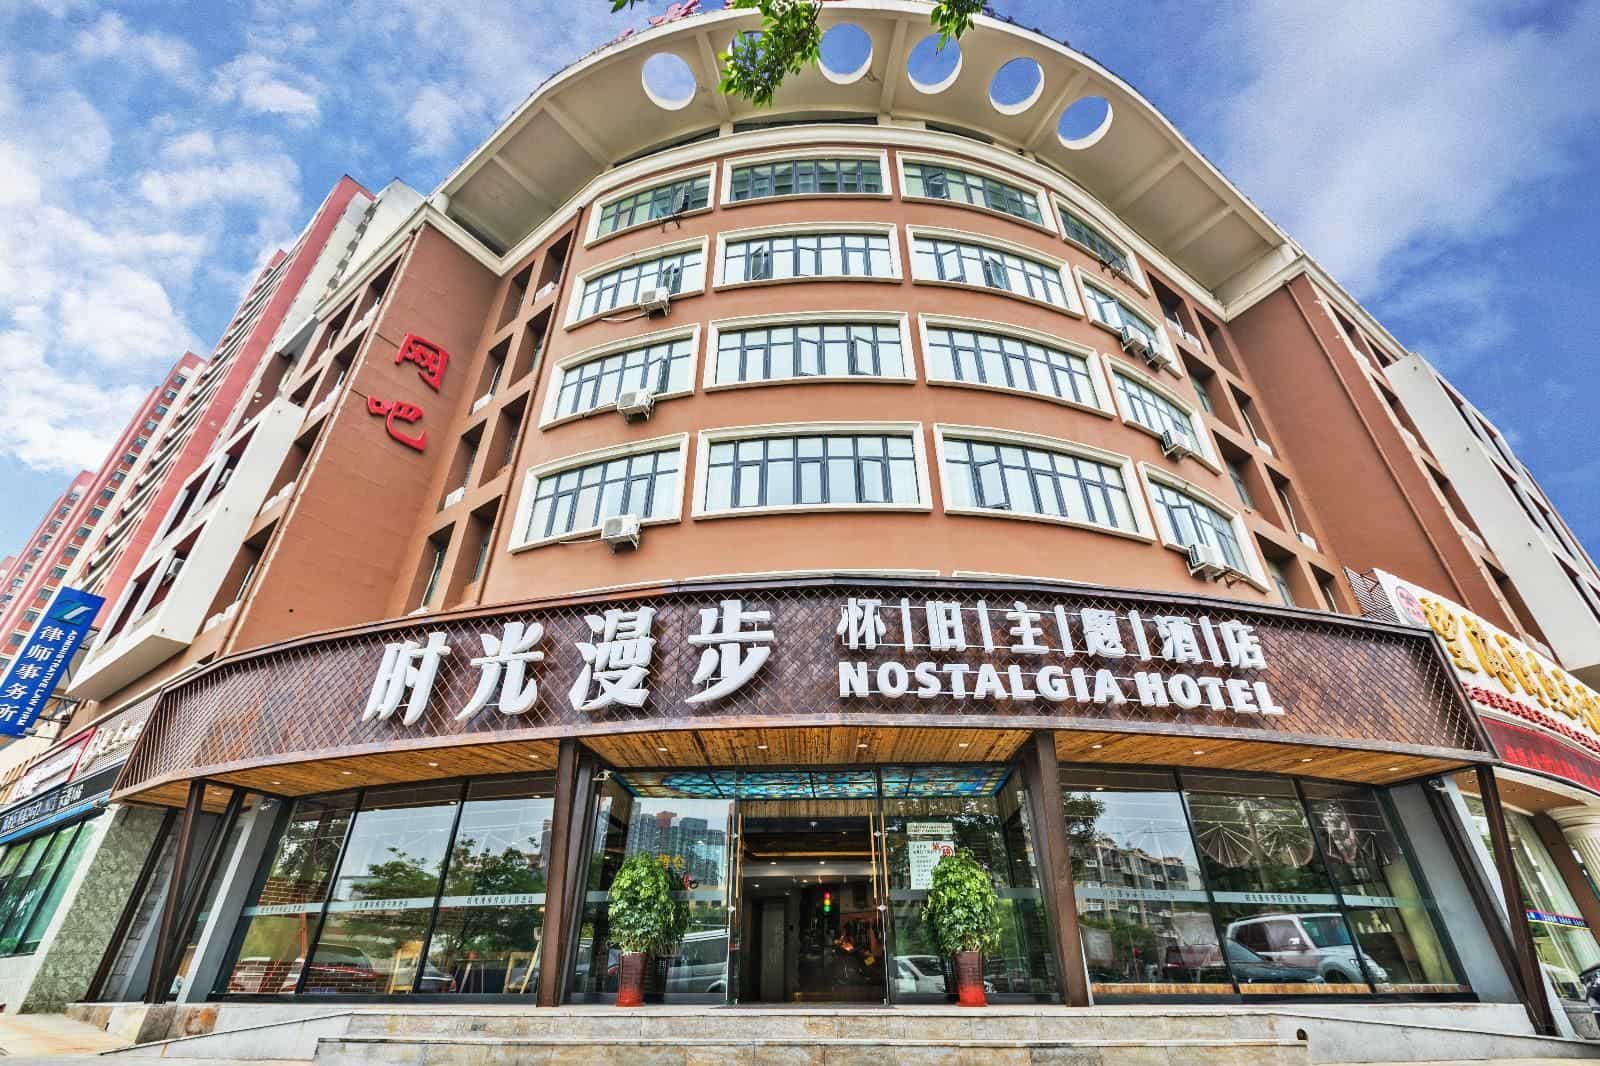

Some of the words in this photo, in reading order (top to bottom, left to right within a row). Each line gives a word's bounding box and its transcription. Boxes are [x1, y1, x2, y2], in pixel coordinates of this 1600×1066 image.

[367, 332, 449, 453] 网吧
[0, 625, 64, 722] 律师事务所
[28, 688, 45, 707] LAW
[361, 599, 776, 726] 时光漫步
[838, 660, 1128, 706] NOSTALGIA
[1133, 670, 1286, 716] HOTEL
